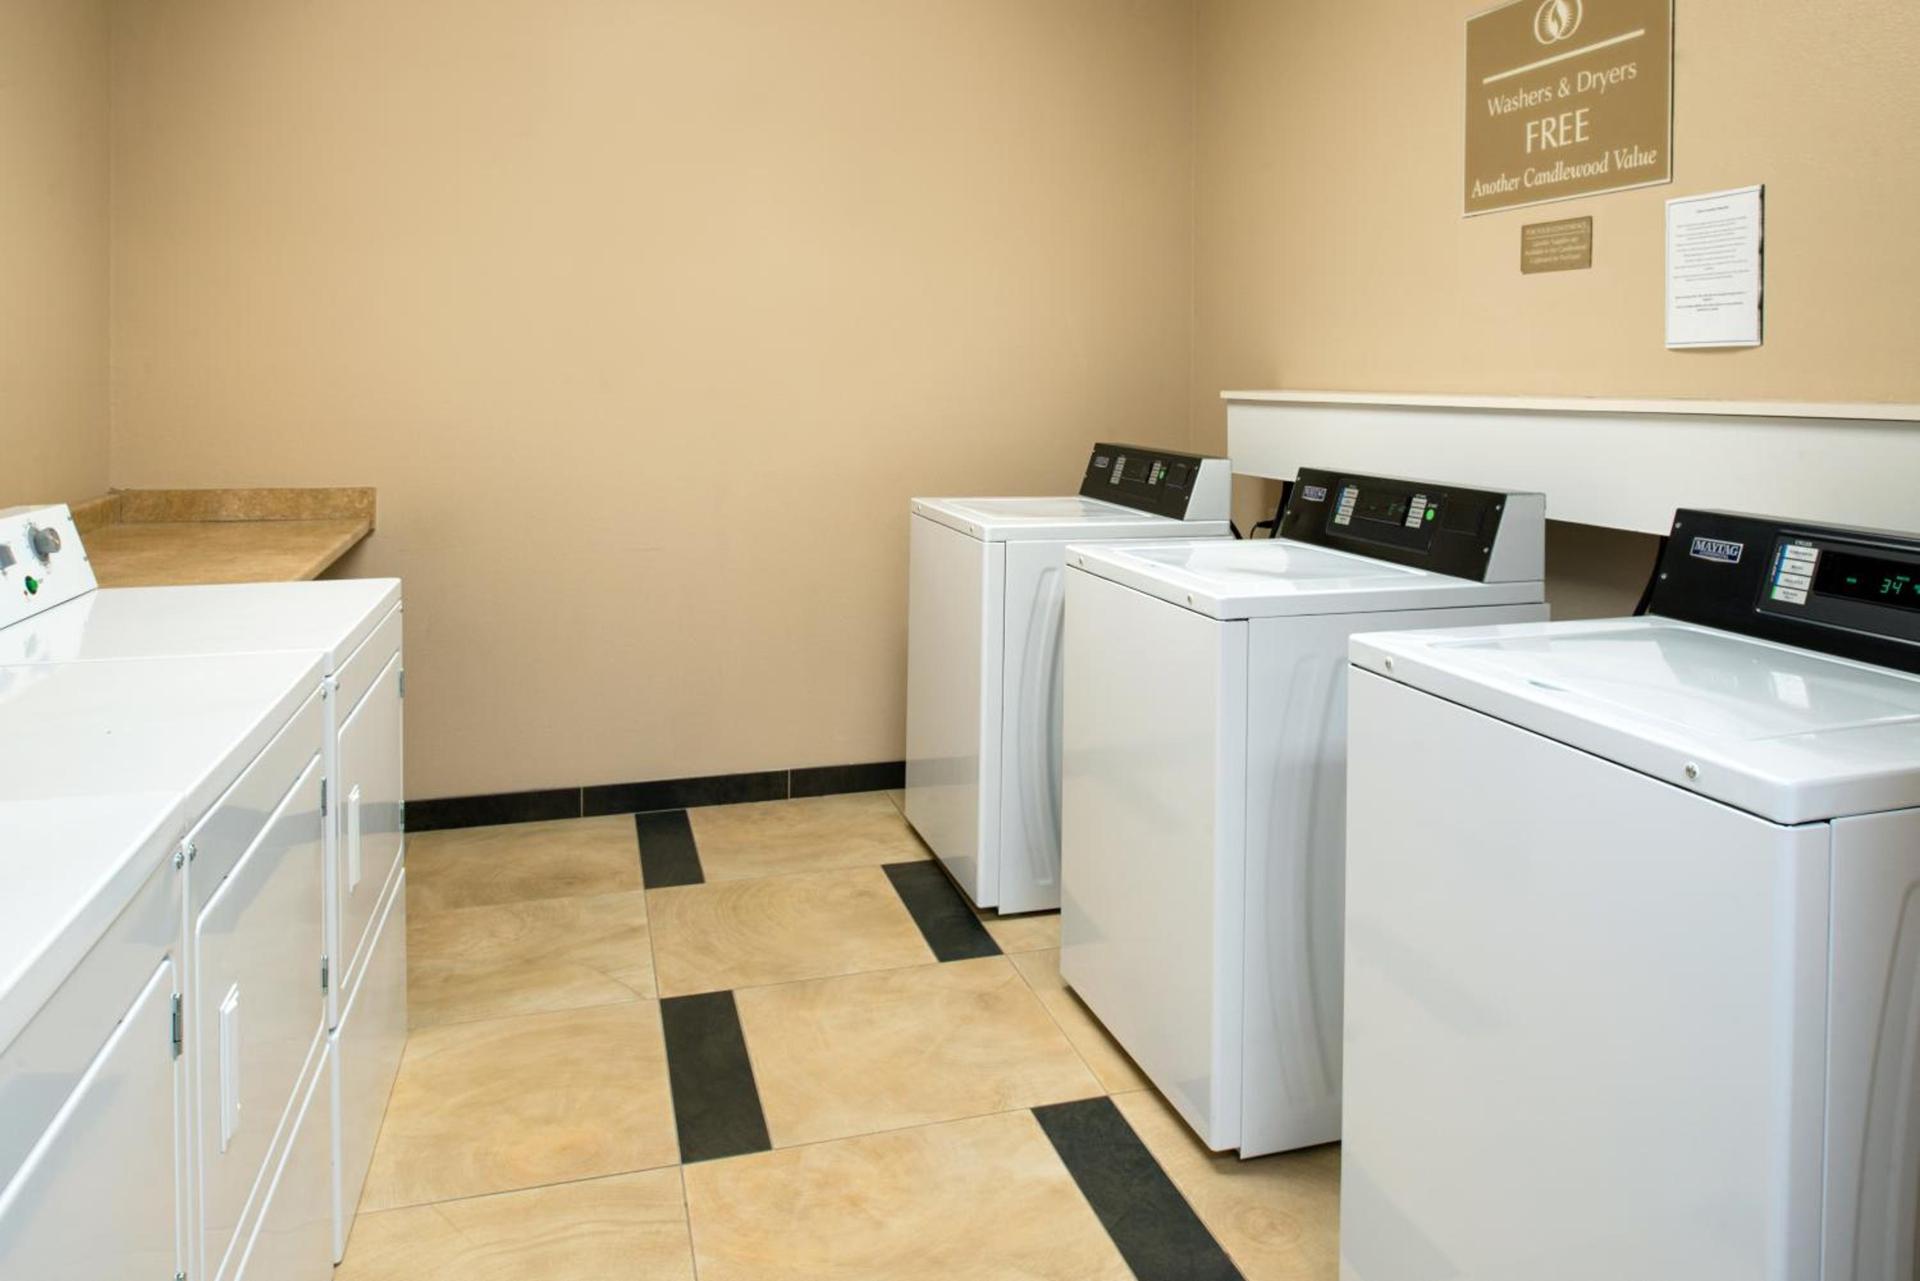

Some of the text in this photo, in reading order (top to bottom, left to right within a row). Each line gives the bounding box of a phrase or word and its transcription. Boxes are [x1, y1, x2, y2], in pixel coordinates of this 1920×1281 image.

[1487, 62, 1637, 117] Washers & Dryers
[1526, 108, 1589, 154] FREE
[1471, 145, 1657, 199] Another Candlewood Value
[1694, 540, 1739, 556] MAYTAG
[1880, 578, 1903, 594] 34
